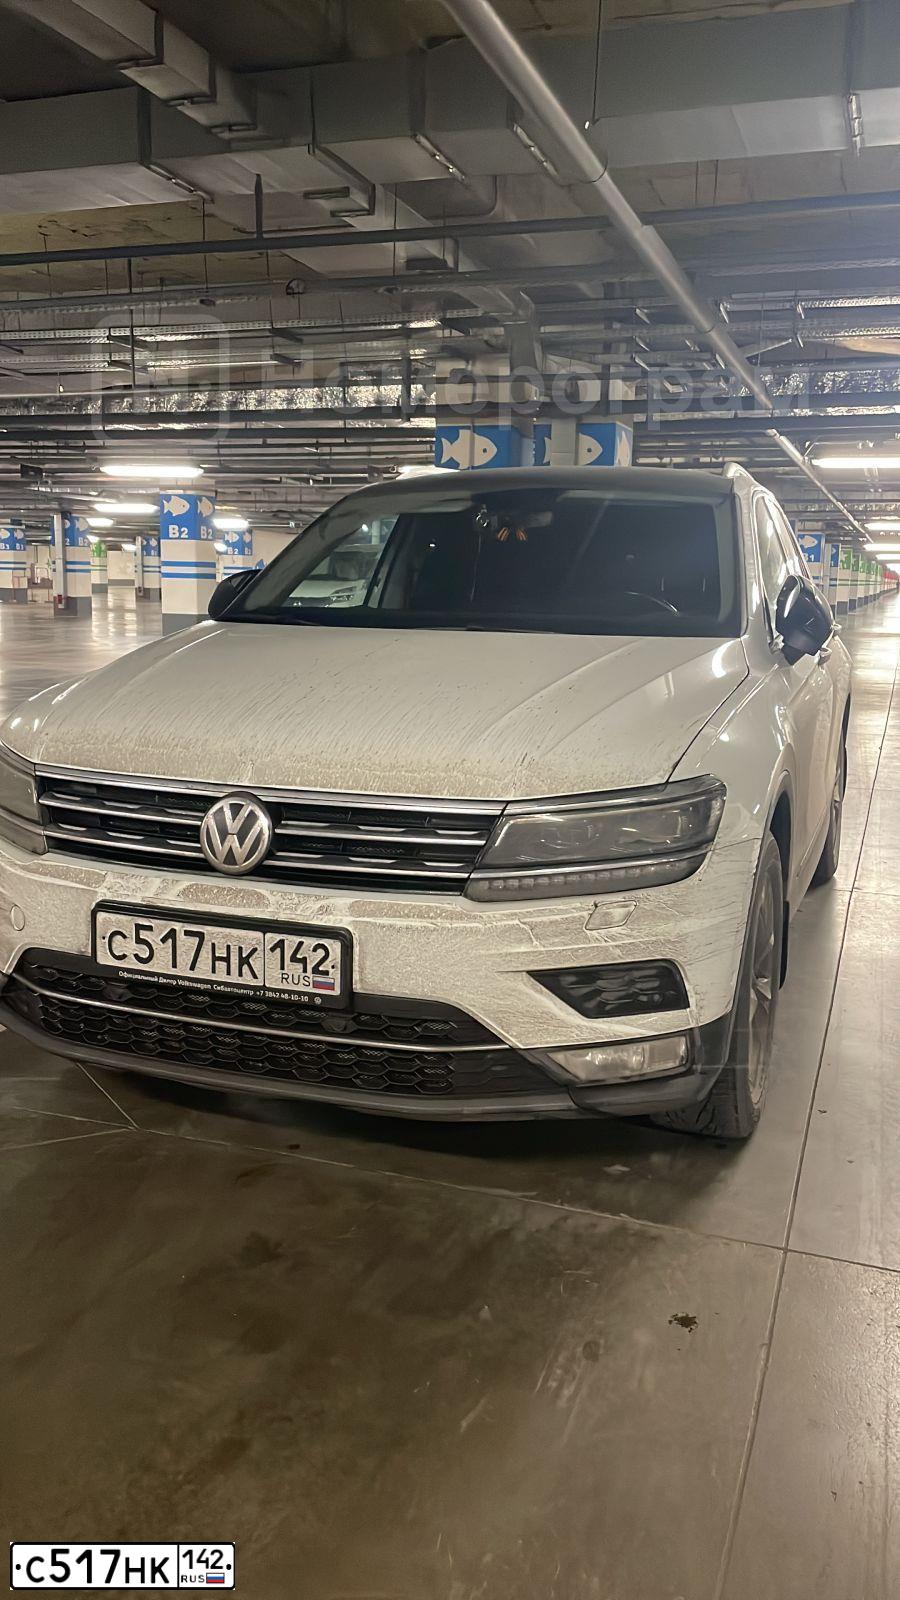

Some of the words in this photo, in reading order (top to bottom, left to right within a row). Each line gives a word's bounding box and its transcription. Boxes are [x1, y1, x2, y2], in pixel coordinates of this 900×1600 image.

[168, 524, 189, 539] B2
[200, 525, 213, 539] B2
[227, 546, 239, 555] B2
[107, 922, 259, 980] С517НК
[269, 938, 330, 976] 142
[177, 979, 212, 990] Volkswagen
[281, 972, 311, 987] RUS
